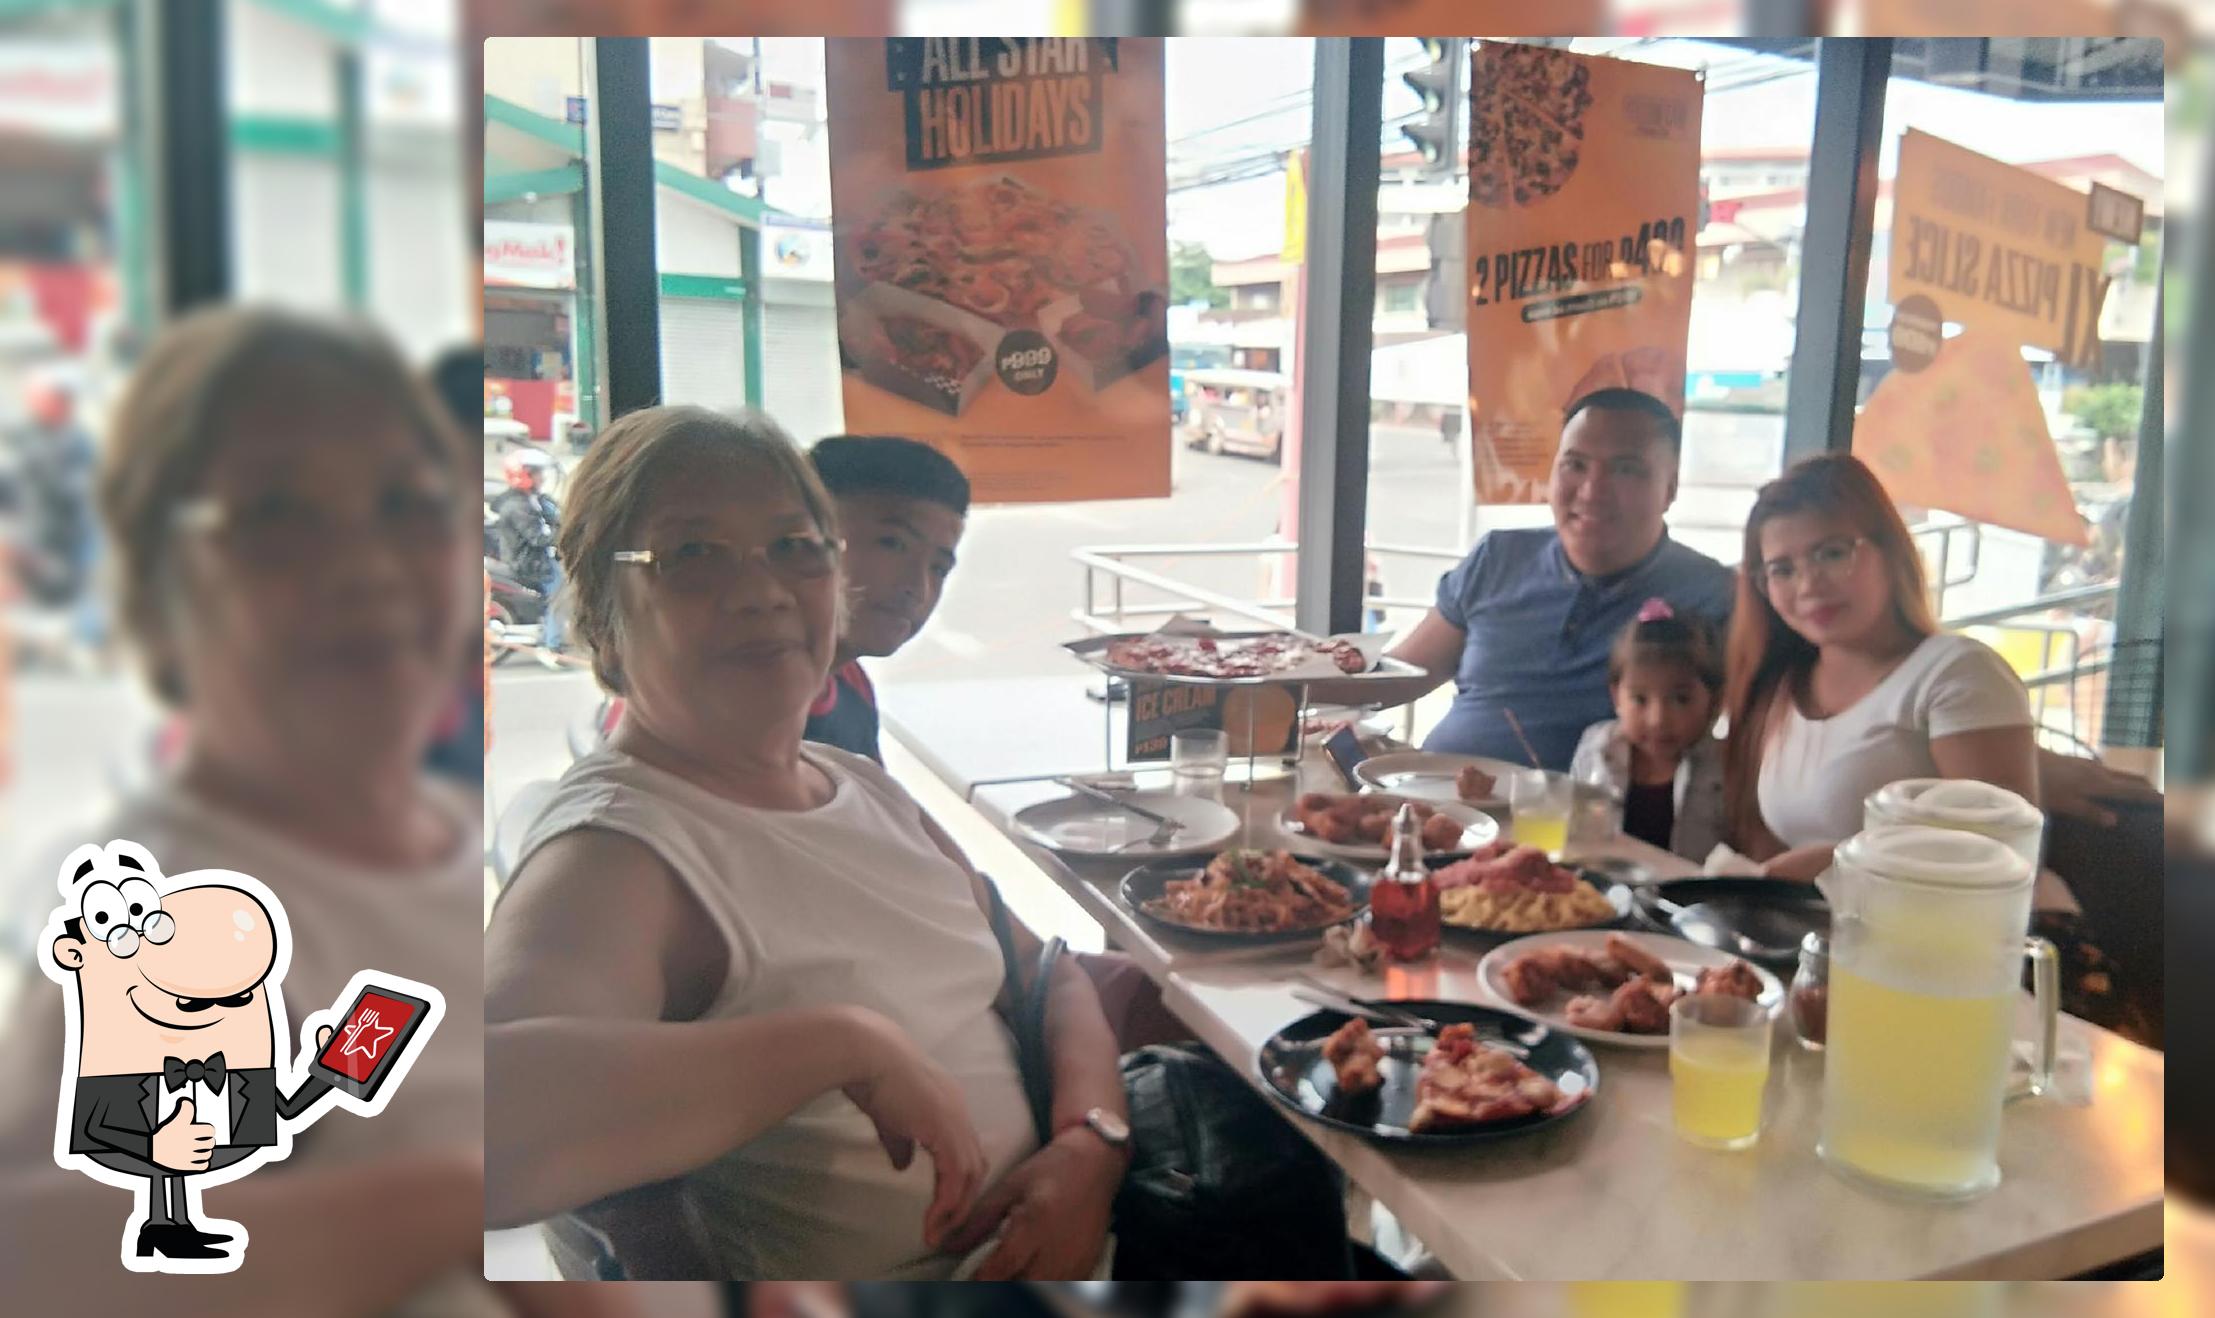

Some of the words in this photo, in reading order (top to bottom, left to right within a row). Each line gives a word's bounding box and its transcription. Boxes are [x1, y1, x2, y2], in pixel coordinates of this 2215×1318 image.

[923, 37, 989, 82] ALL
[997, 37, 1088, 77] STAR
[920, 77, 1092, 160] HOLIDAYS
[1475, 255, 1489, 305] 2
[1494, 242, 1579, 304] PIZZAS
[1582, 240, 1615, 281] FOR
[1135, 690, 1161, 722] ICE
